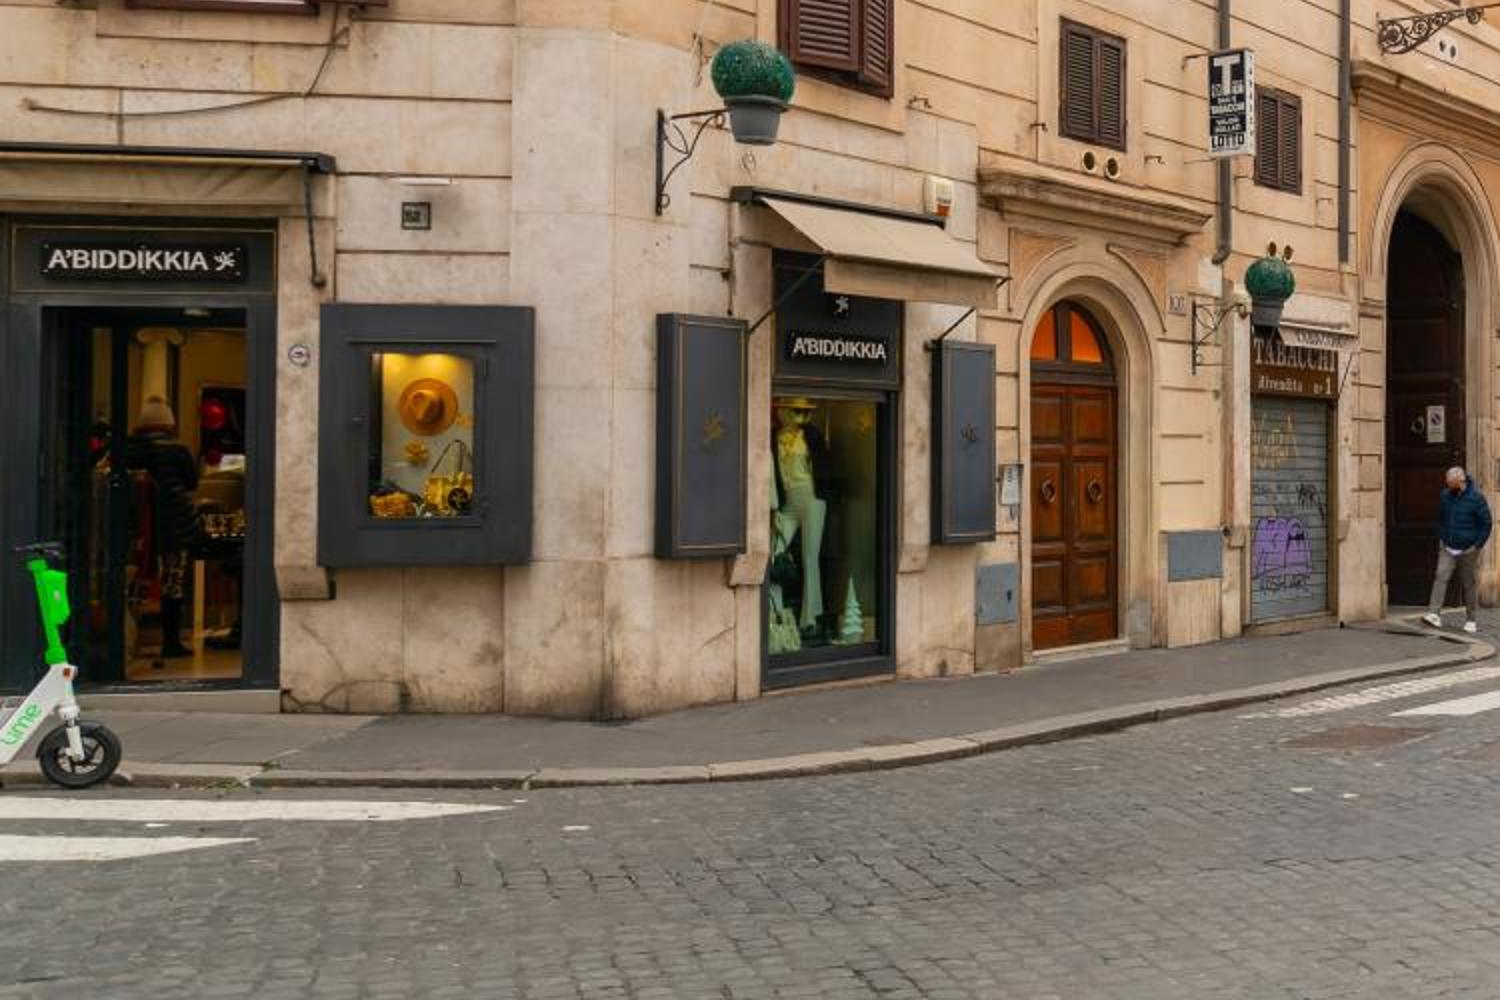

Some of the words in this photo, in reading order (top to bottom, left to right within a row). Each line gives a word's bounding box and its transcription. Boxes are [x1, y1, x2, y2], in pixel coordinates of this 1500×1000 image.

[1213, 54, 1241, 95] T
[1211, 133, 1245, 148] LOTTO
[48, 248, 209, 271] A'BIDDIKKIA
[1253, 337, 1336, 373] TABACCHI
[1325, 376, 1332, 396] 1
